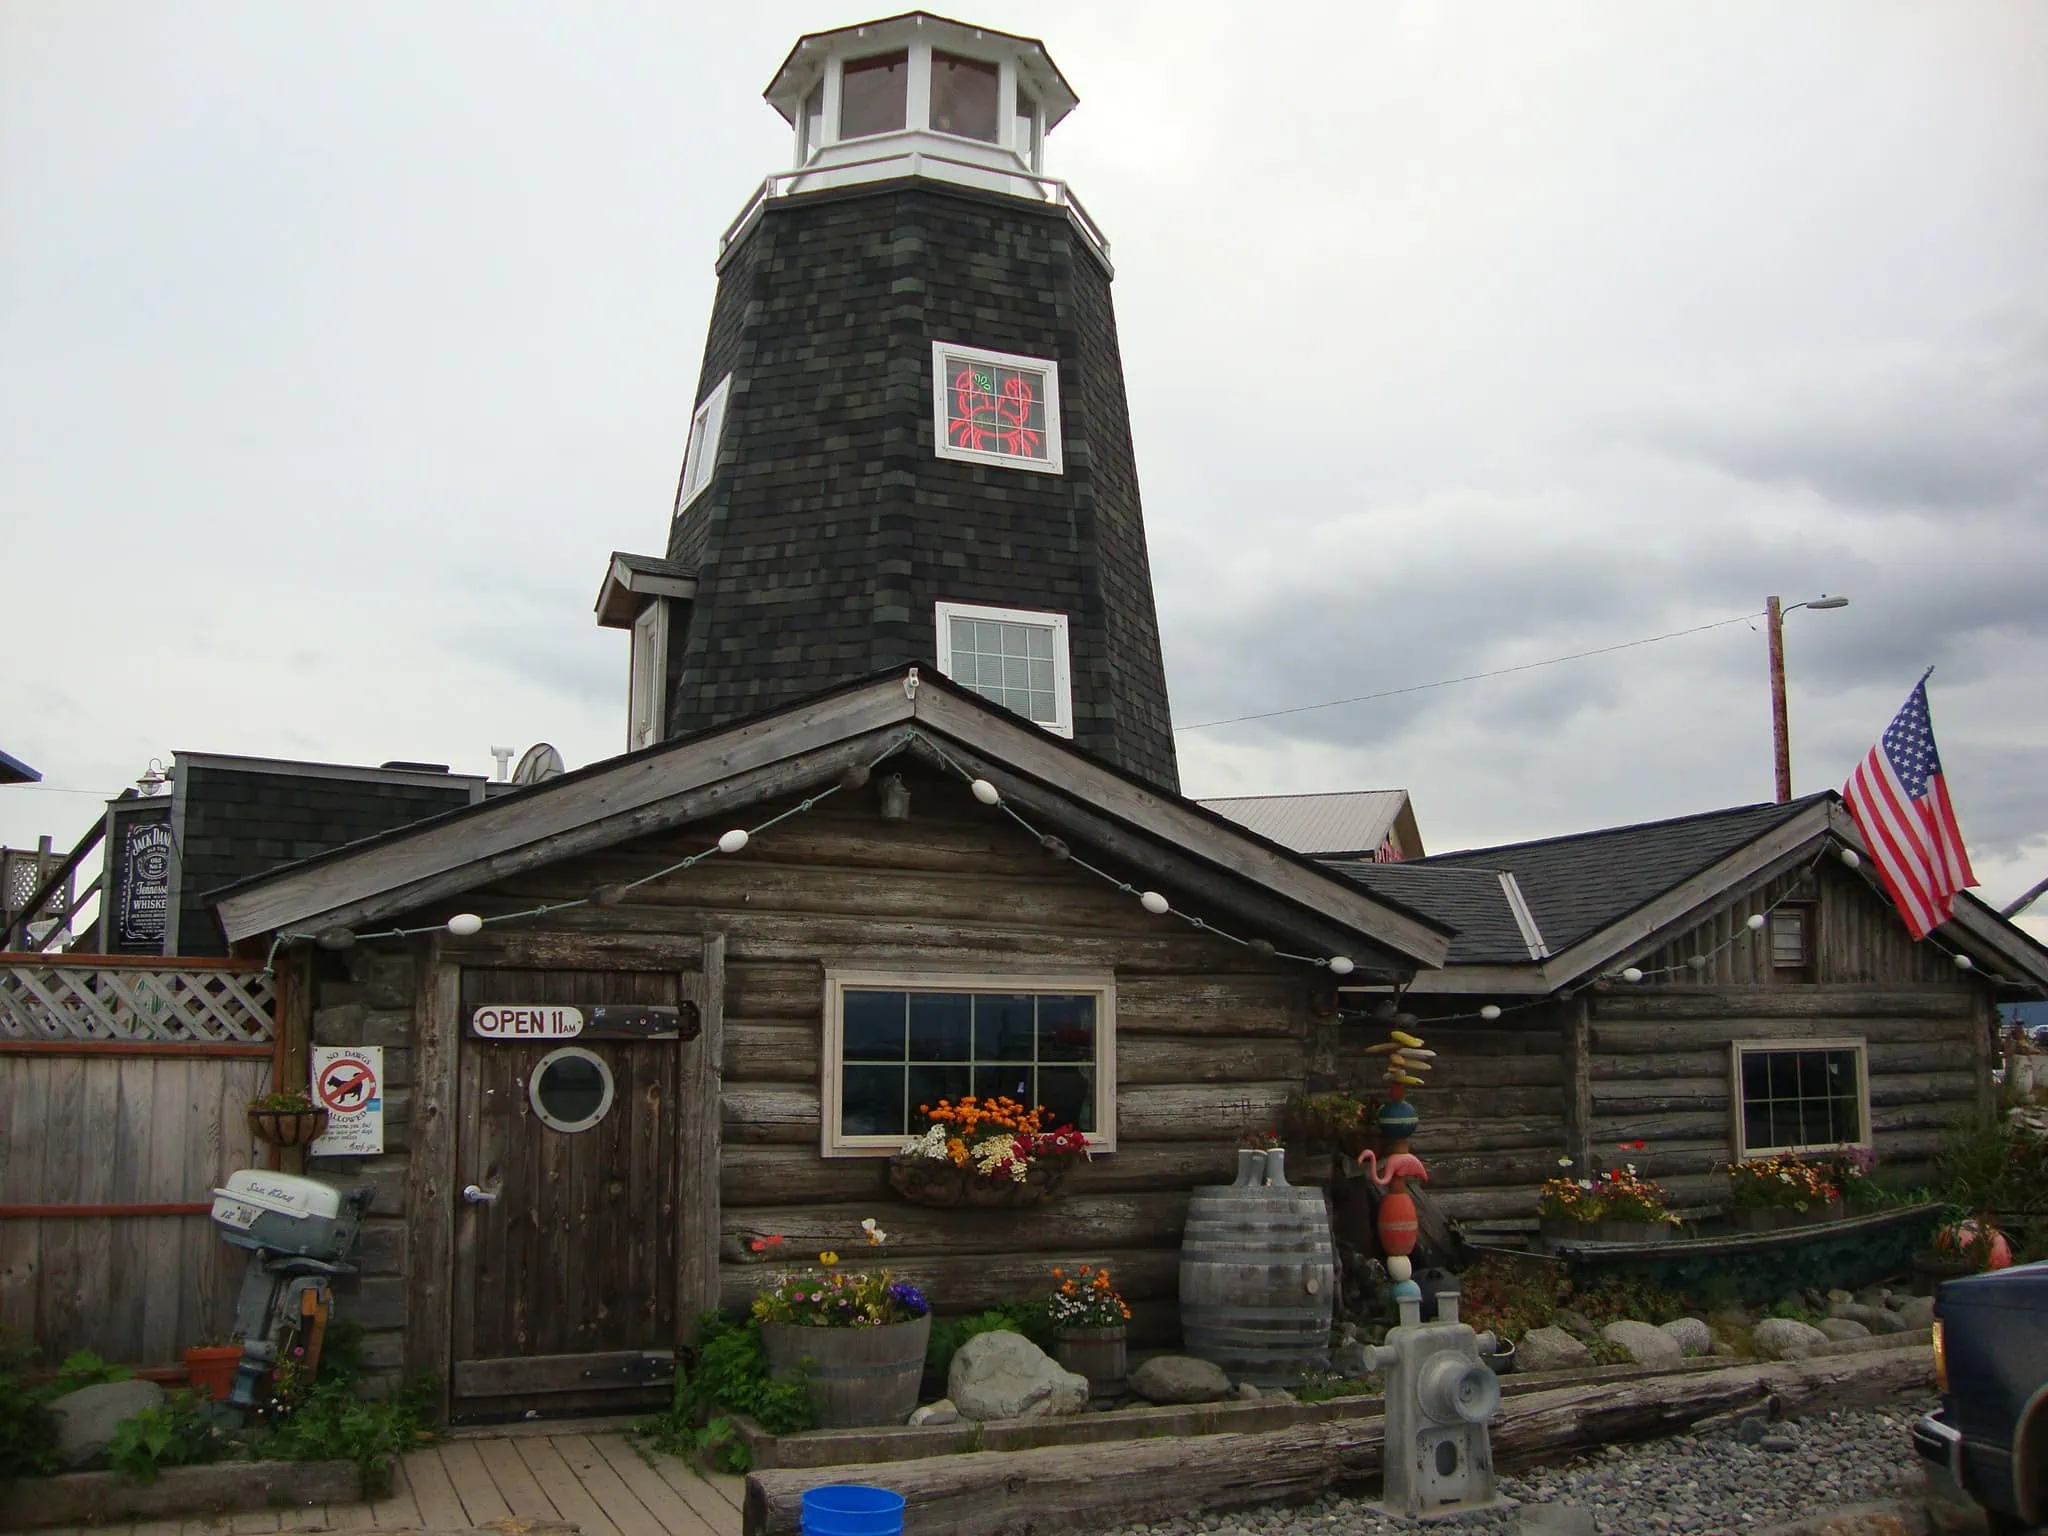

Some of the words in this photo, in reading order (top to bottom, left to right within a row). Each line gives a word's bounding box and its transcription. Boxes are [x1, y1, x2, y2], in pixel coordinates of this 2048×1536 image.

[478, 1010, 544, 1034] OPEN
[326, 1051, 339, 1062] NO
[329, 1110, 367, 1123] ALLOWED
